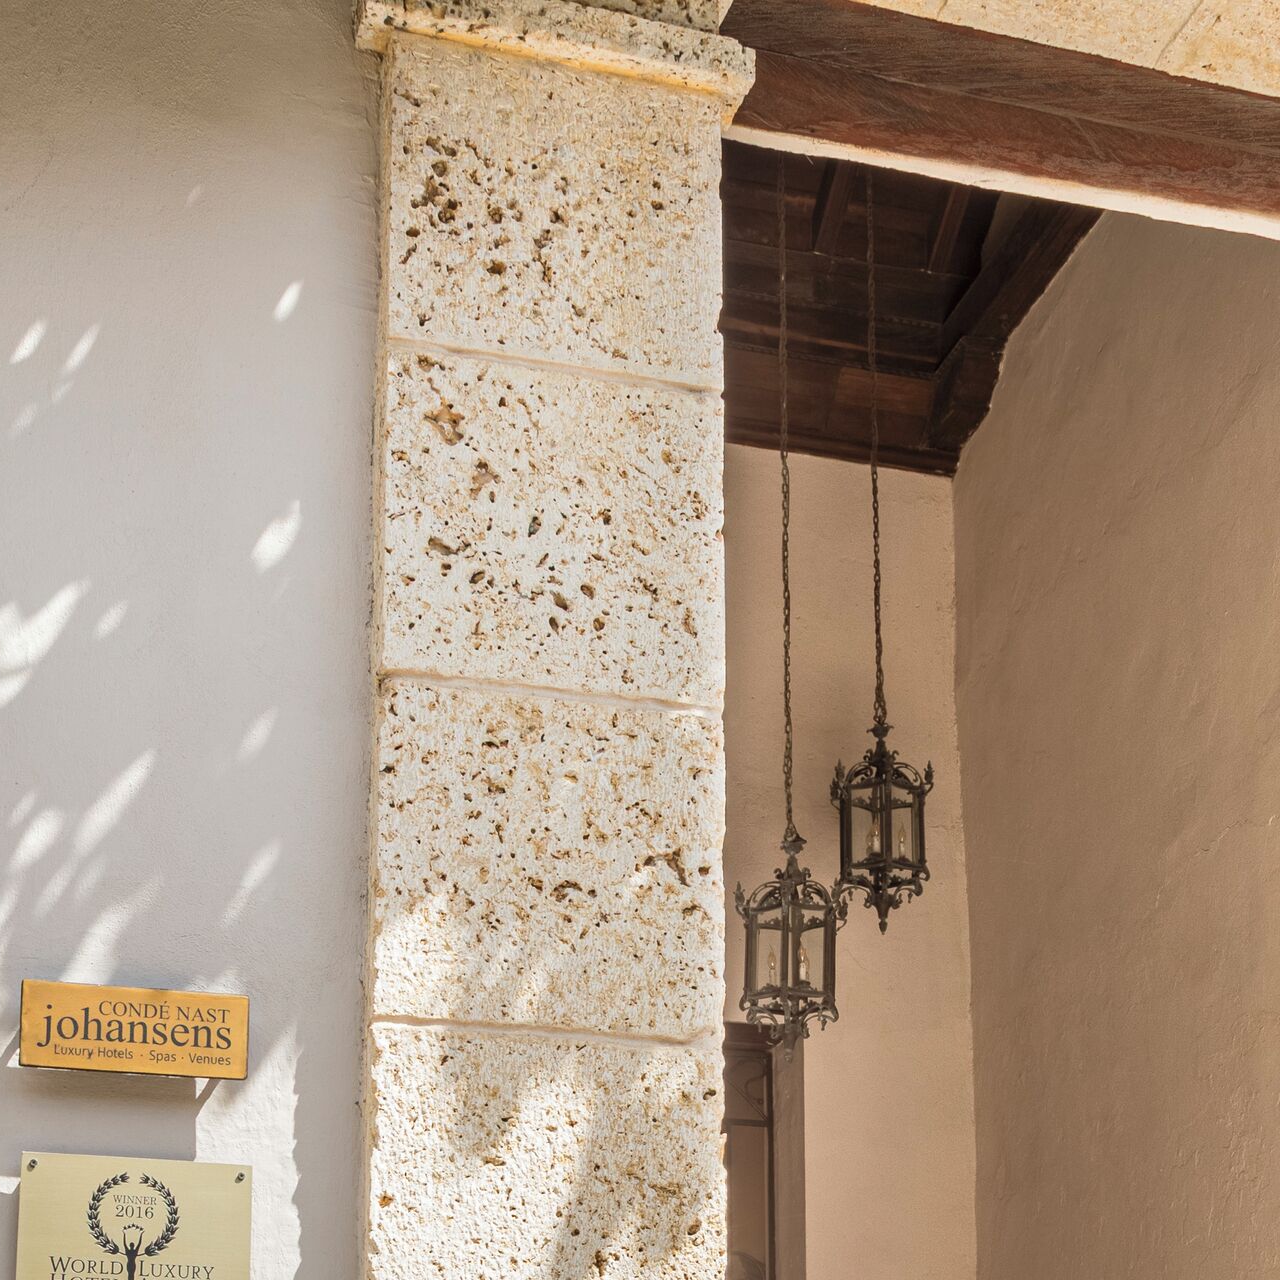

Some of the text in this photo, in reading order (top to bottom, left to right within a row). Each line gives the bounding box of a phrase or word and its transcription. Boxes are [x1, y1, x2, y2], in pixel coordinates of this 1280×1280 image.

[99, 1000, 231, 1024] CONDÉ NAST
[36, 1004, 232, 1050] johansens
[54, 1044, 232, 1066] Luxury Hotels Spas Venues
[113, 1194, 158, 1206] WINNER
[115, 1204, 154, 1220] 2016
[49, 1256, 215, 1280] WORLD LUXURY
